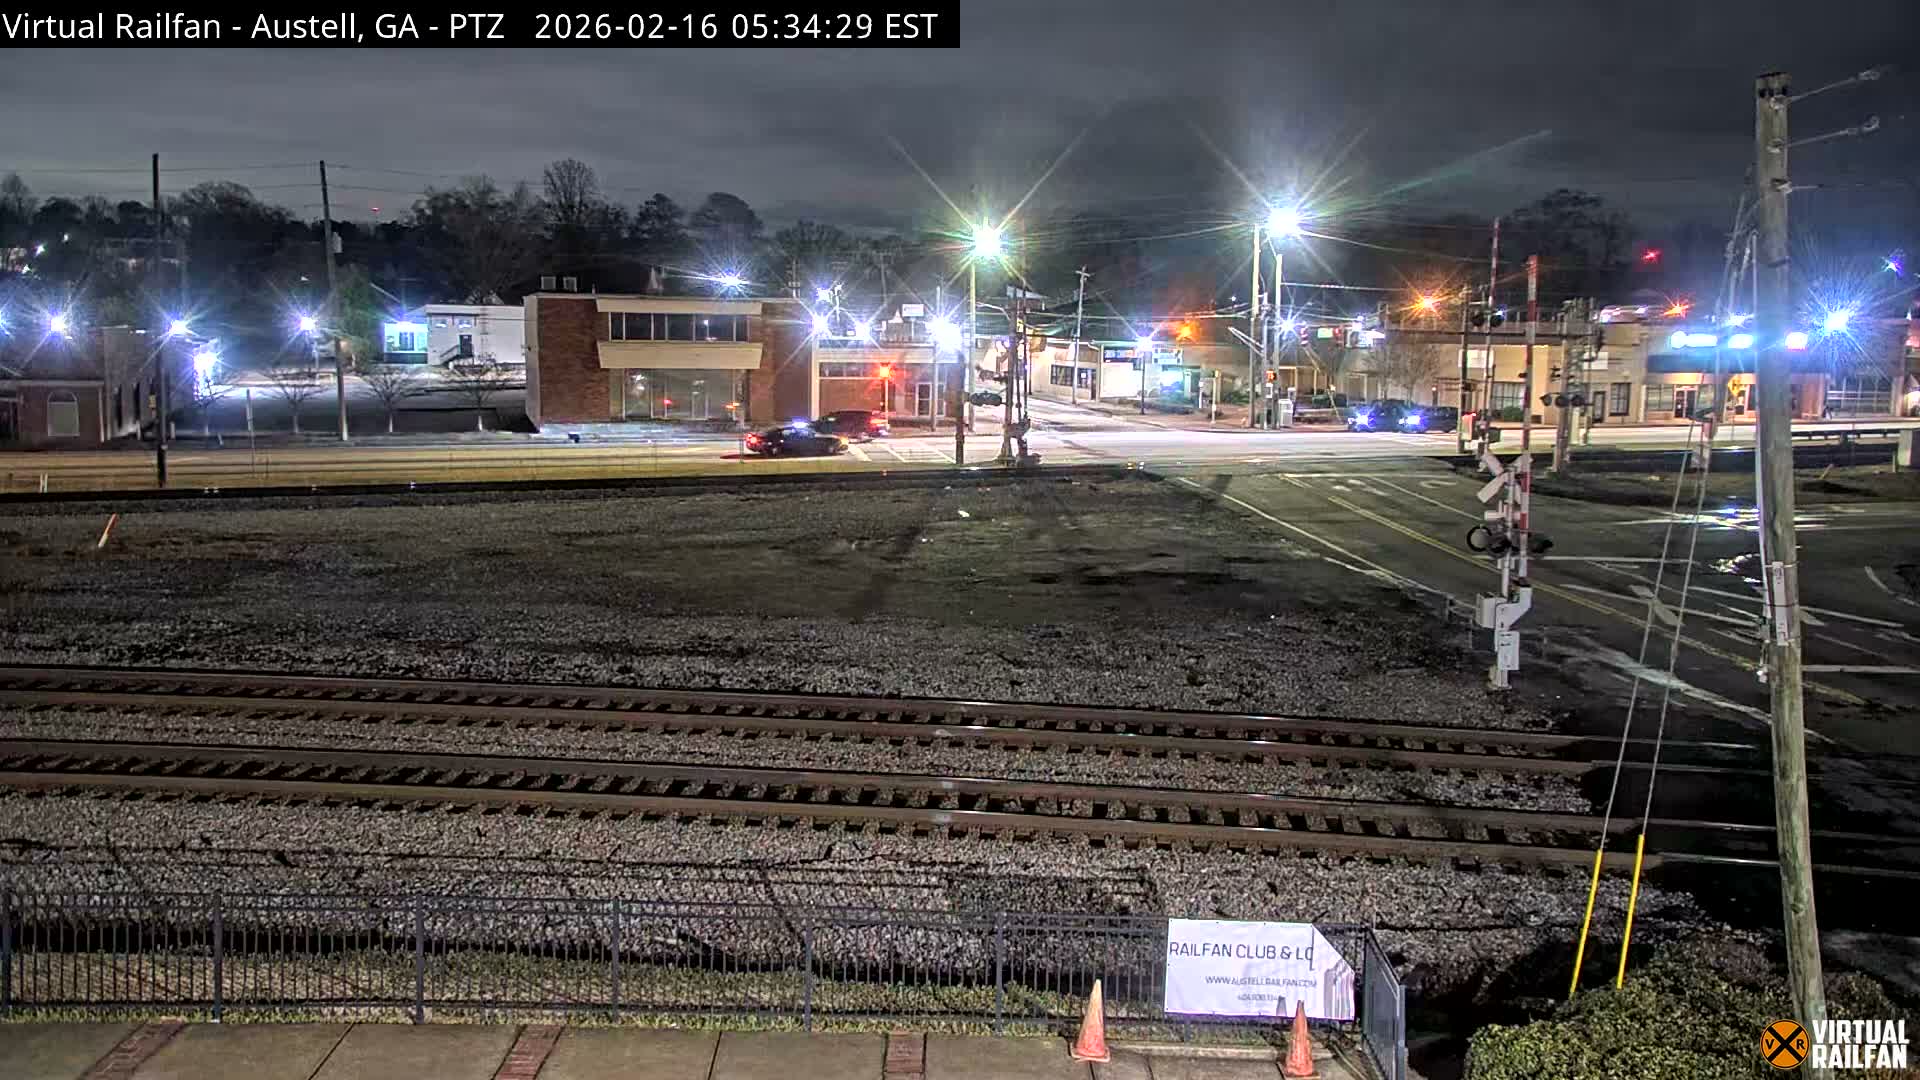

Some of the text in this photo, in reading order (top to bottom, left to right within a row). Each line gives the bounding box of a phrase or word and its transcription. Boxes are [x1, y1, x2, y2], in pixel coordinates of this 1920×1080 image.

[1169, 941, 1233, 957] RAILFAN
[1235, 943, 1277, 960] CLUB
[1280, 945, 1293, 960] &
